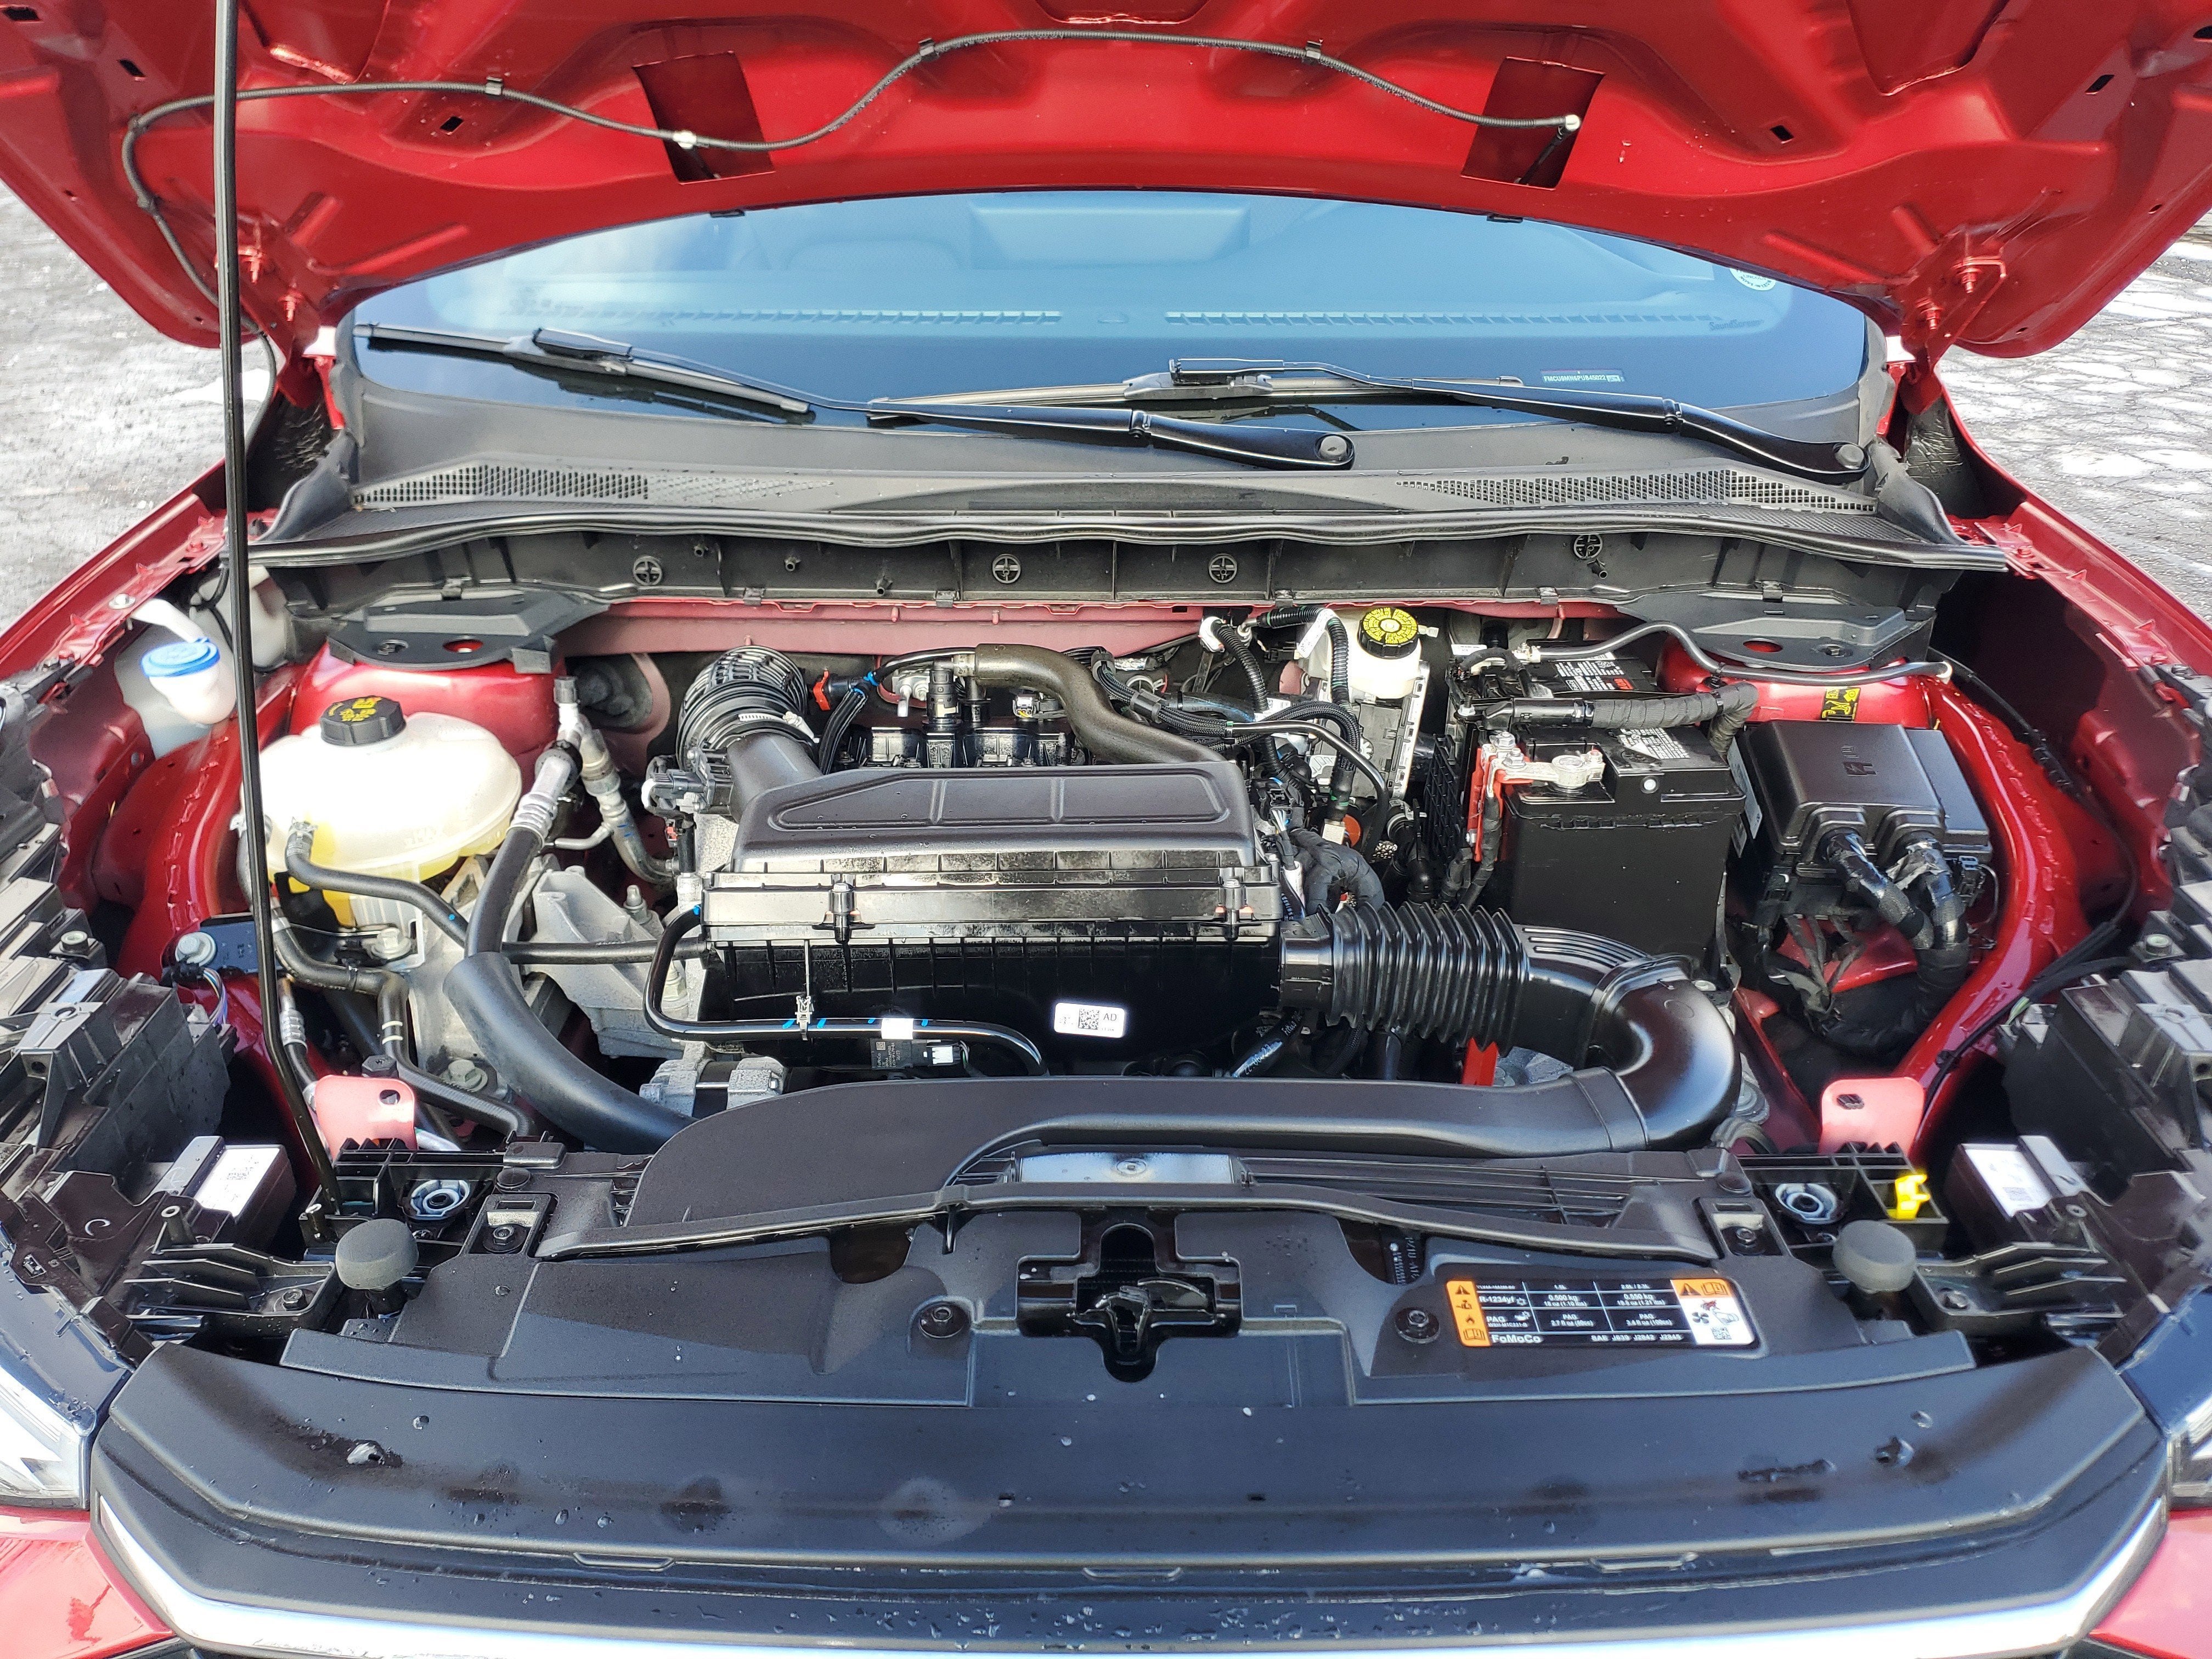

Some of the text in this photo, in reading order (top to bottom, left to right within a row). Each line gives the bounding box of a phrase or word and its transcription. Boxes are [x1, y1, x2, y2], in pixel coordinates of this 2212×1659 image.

[1103, 1013, 1117, 1021] AD
[1479, 1296, 1515, 1304] R-1234yf
[1567, 1294, 1579, 1303] kg
[1643, 1293, 1655, 1302] kg
[1491, 1335, 1542, 1344] FoMoCo
